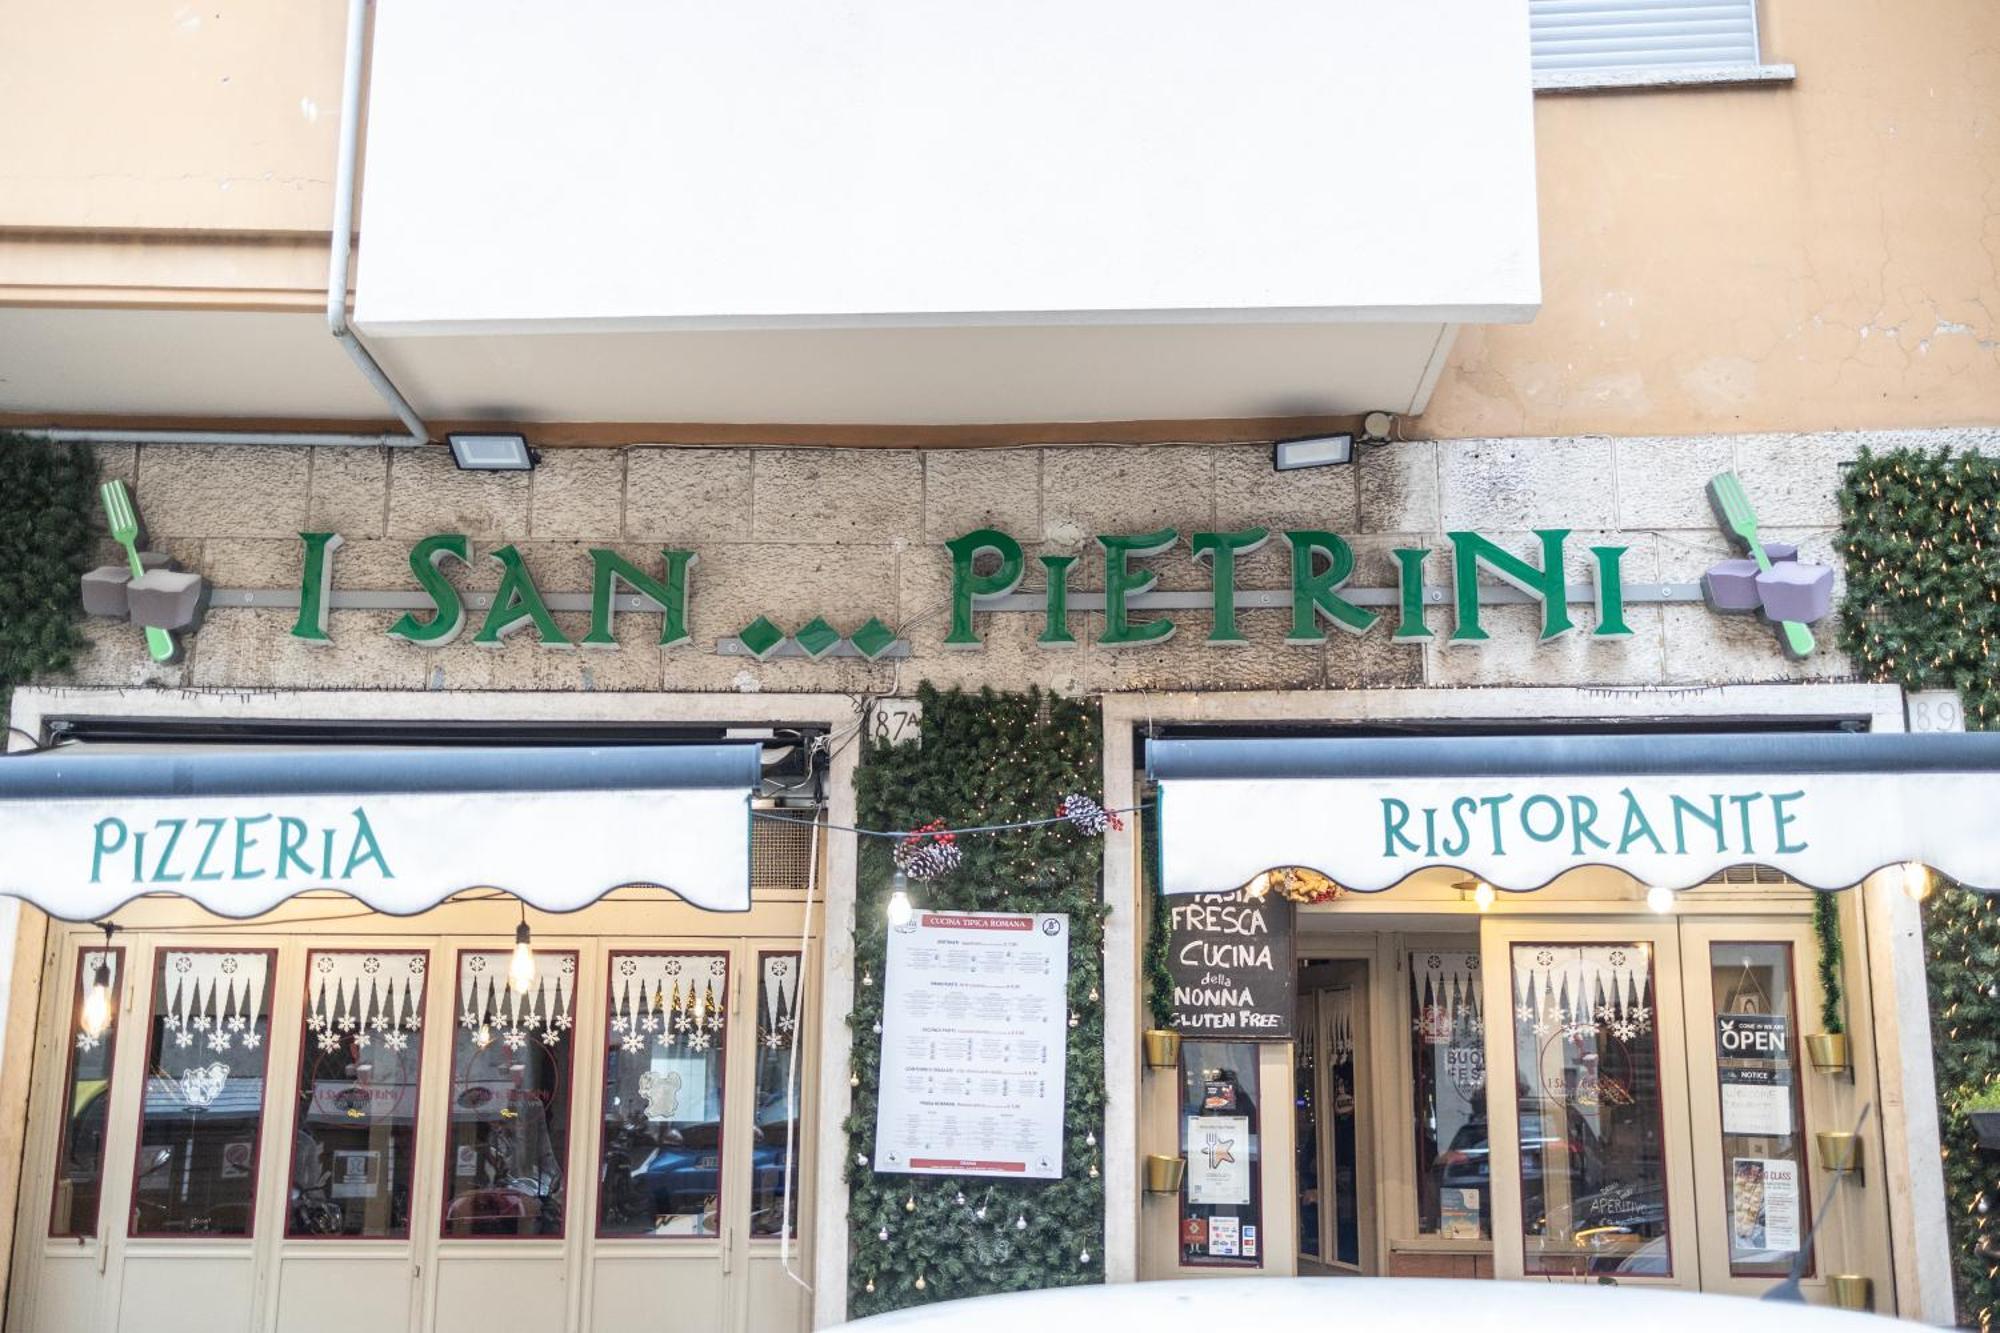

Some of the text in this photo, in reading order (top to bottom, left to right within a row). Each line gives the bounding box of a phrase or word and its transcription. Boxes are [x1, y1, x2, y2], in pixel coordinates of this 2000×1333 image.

[290, 526, 1634, 649] I SAN PIETRINI
[1916, 702, 1956, 731] 89
[1380, 787, 1809, 857] RISTORANTE
[89, 806, 395, 883] PIZZERIA
[930, 917, 1026, 928] CUCINA TIPICA ROMANA
[1171, 904, 1268, 935] FRESCA
[1180, 940, 1274, 971] CUCINA
[1201, 971, 1232, 987] della
[1174, 986, 1254, 1007] NONNA
[1169, 1010, 1281, 1029] GLUTEN FREE
[1722, 1030, 1786, 1051] OPEN
[1447, 1050, 1482, 1064] BUO
[1447, 1067, 1481, 1081] FES
[1740, 1071, 1768, 1079] NOTICE
